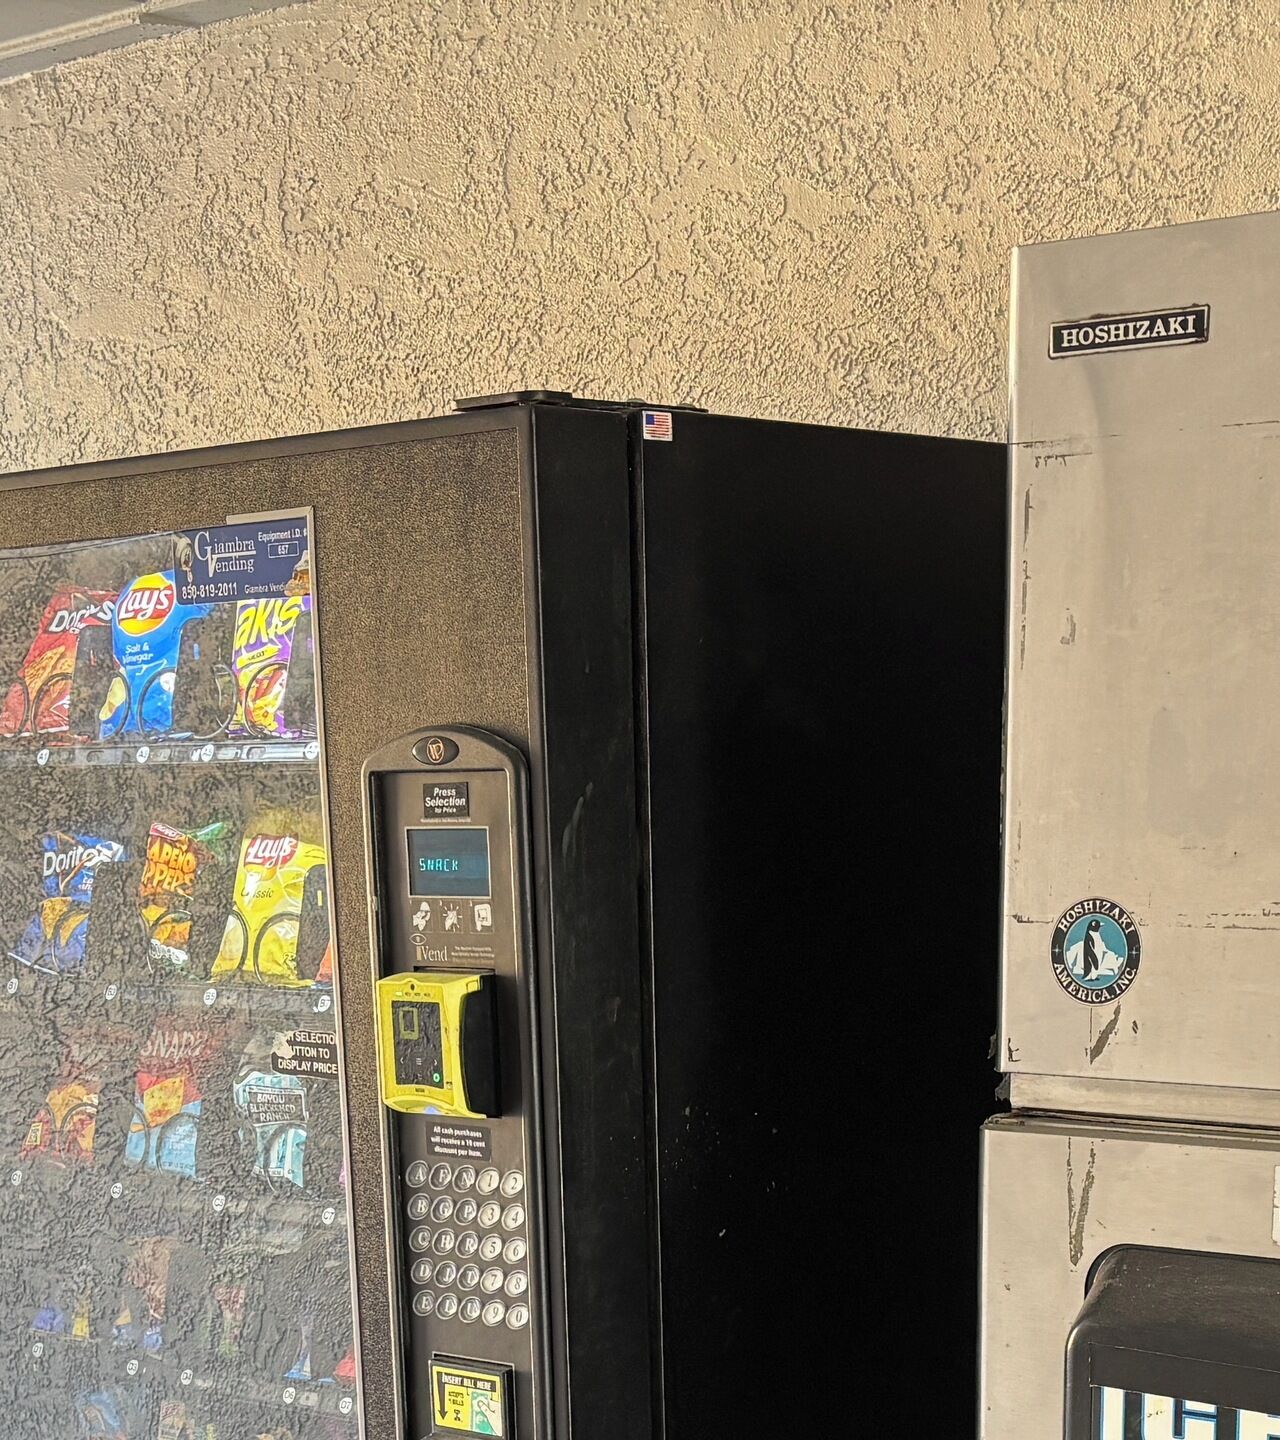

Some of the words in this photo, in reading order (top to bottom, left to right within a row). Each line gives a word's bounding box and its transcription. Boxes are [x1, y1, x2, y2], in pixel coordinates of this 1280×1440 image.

[1060, 315, 1196, 347] HOSHIZAKI
[194, 531, 255, 560] Giambra
[258, 531, 291, 542] Equipment
[207, 555, 255, 578] Vending
[181, 581, 238, 600] 850-819-2011
[125, 643, 141, 654] Salt
[142, 642, 150, 651] &
[122, 653, 154, 665] Vinegar
[433, 787, 456, 797] Press
[425, 797, 466, 807] Selection
[419, 858, 459, 872] SNACK
[241, 888, 274, 899] Cssic
[1058, 900, 1136, 935] HOSHIZAKI
[1113, 967, 1136, 995] INC.
[295, 1031, 336, 1045] SELECTIO
[292, 1046, 317, 1059] UTTON
[318, 1047, 330, 1059] TO
[278, 1059, 311, 1072] DISPLAY
[313, 1062, 339, 1074] PRICE
[441, 1127, 453, 1135] cash
[454, 1129, 482, 1138] purchases
[415, 1168, 424, 1181] A
[439, 1169, 446, 1182] F
[460, 1172, 470, 1186] N
[487, 1175, 493, 1187] 1
[511, 1177, 518, 1190] 2
[417, 1200, 425, 1213] B
[439, 1202, 448, 1216] G
[464, 1205, 471, 1219] P
[488, 1209, 495, 1221] 3
[512, 1211, 519, 1224] 4
[419, 1232, 428, 1245] C
[441, 1235, 451, 1248] H
[465, 1238, 473, 1251] R
[489, 1241, 496, 1253] 5
[513, 1245, 519, 1257] 6
[420, 1264, 429, 1278] D
[443, 1268, 452, 1281] J
[491, 1274, 497, 1287] 7
[515, 1277, 521, 1290] 8
[422, 1296, 429, 1309] E
[493, 1307, 499, 1319] 9
[516, 1310, 522, 1323] 0
[442, 1373, 462, 1385] INSERT
[463, 1378, 475, 1388] BILL
[477, 1381, 492, 1390] HERE
